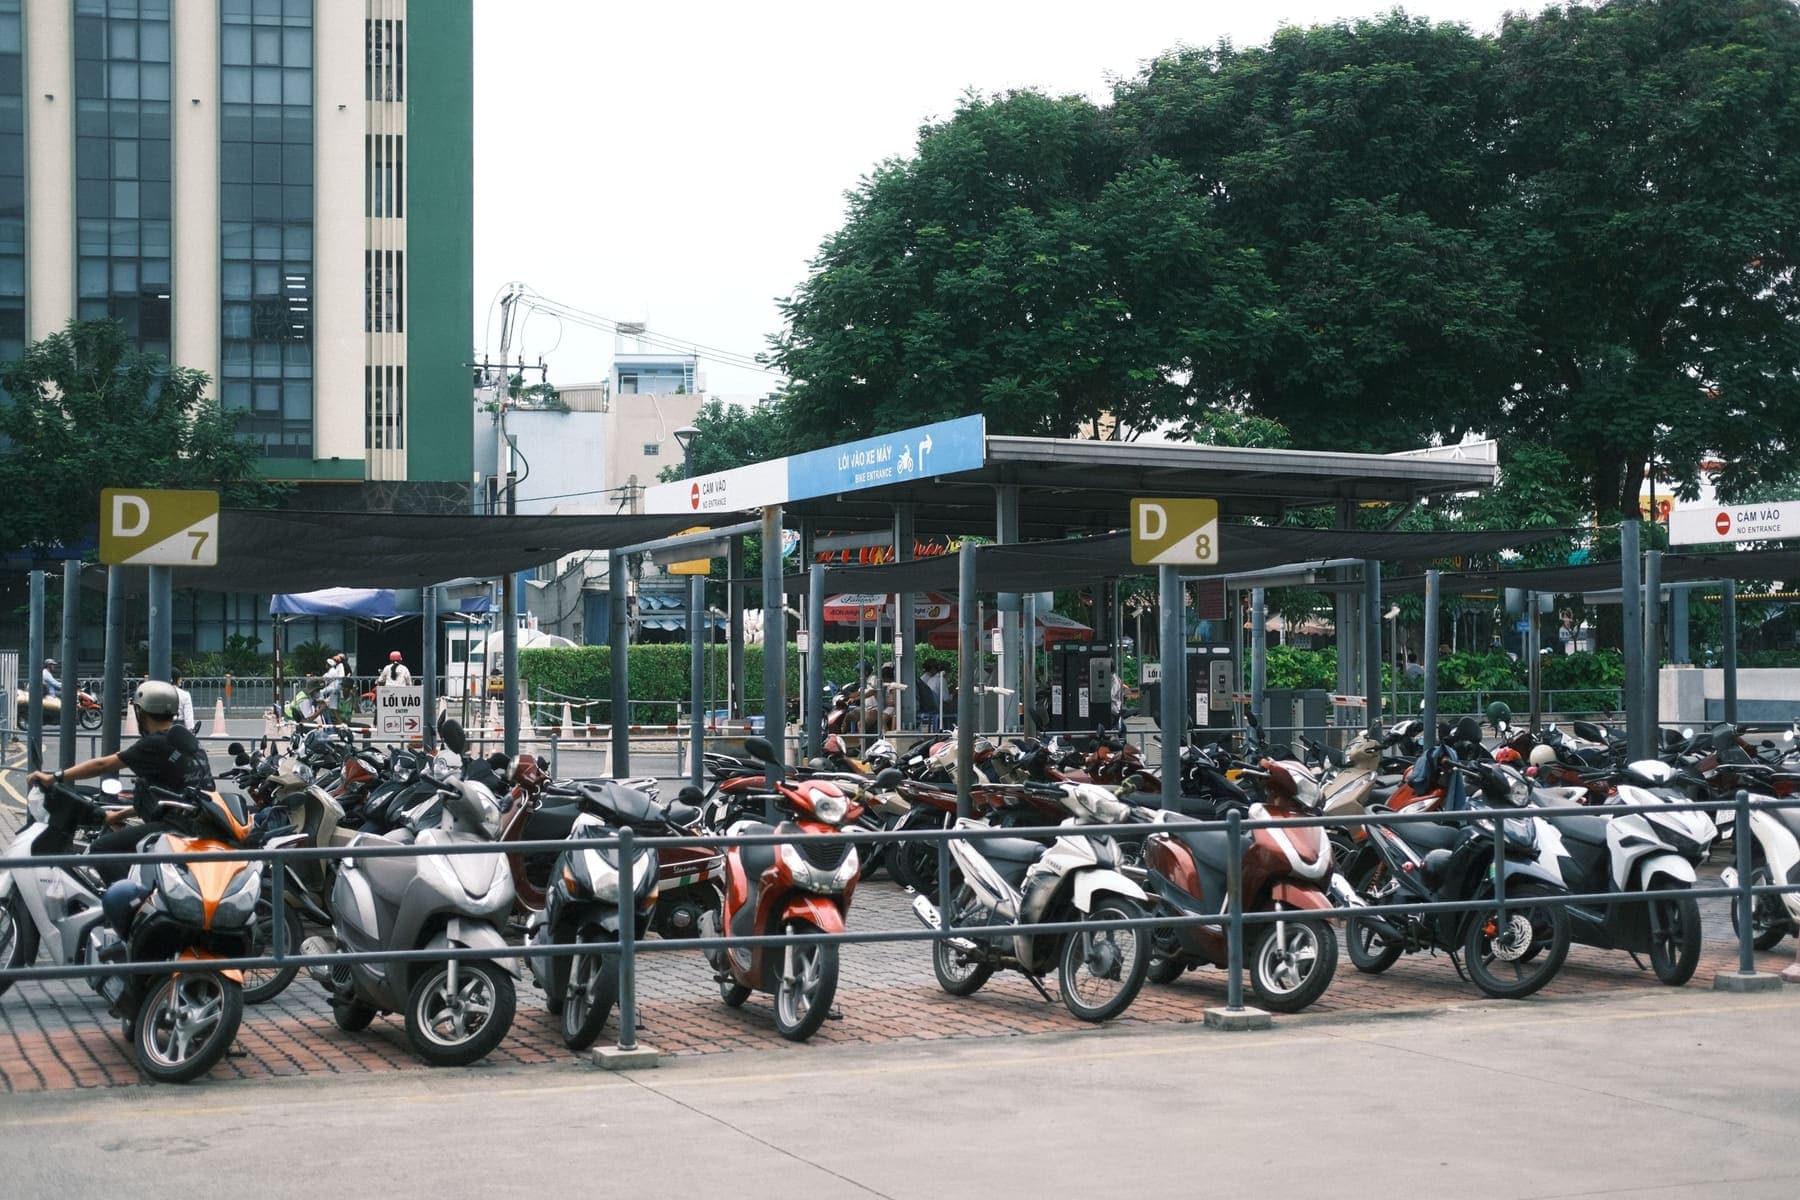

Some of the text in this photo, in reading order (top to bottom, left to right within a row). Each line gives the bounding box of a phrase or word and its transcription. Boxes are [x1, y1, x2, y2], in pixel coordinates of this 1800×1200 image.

[866, 449, 875, 465] XE
[867, 467, 892, 481] ENTRANCE
[112, 495, 150, 537] D
[1139, 503, 1168, 541] D
[1760, 508, 1780, 521] VÀO
[1748, 525, 1781, 533] ENTRANCE
[187, 531, 210, 560] 7
[1195, 533, 1212, 560] 8
[383, 693, 420, 707] LỐI VÀO
